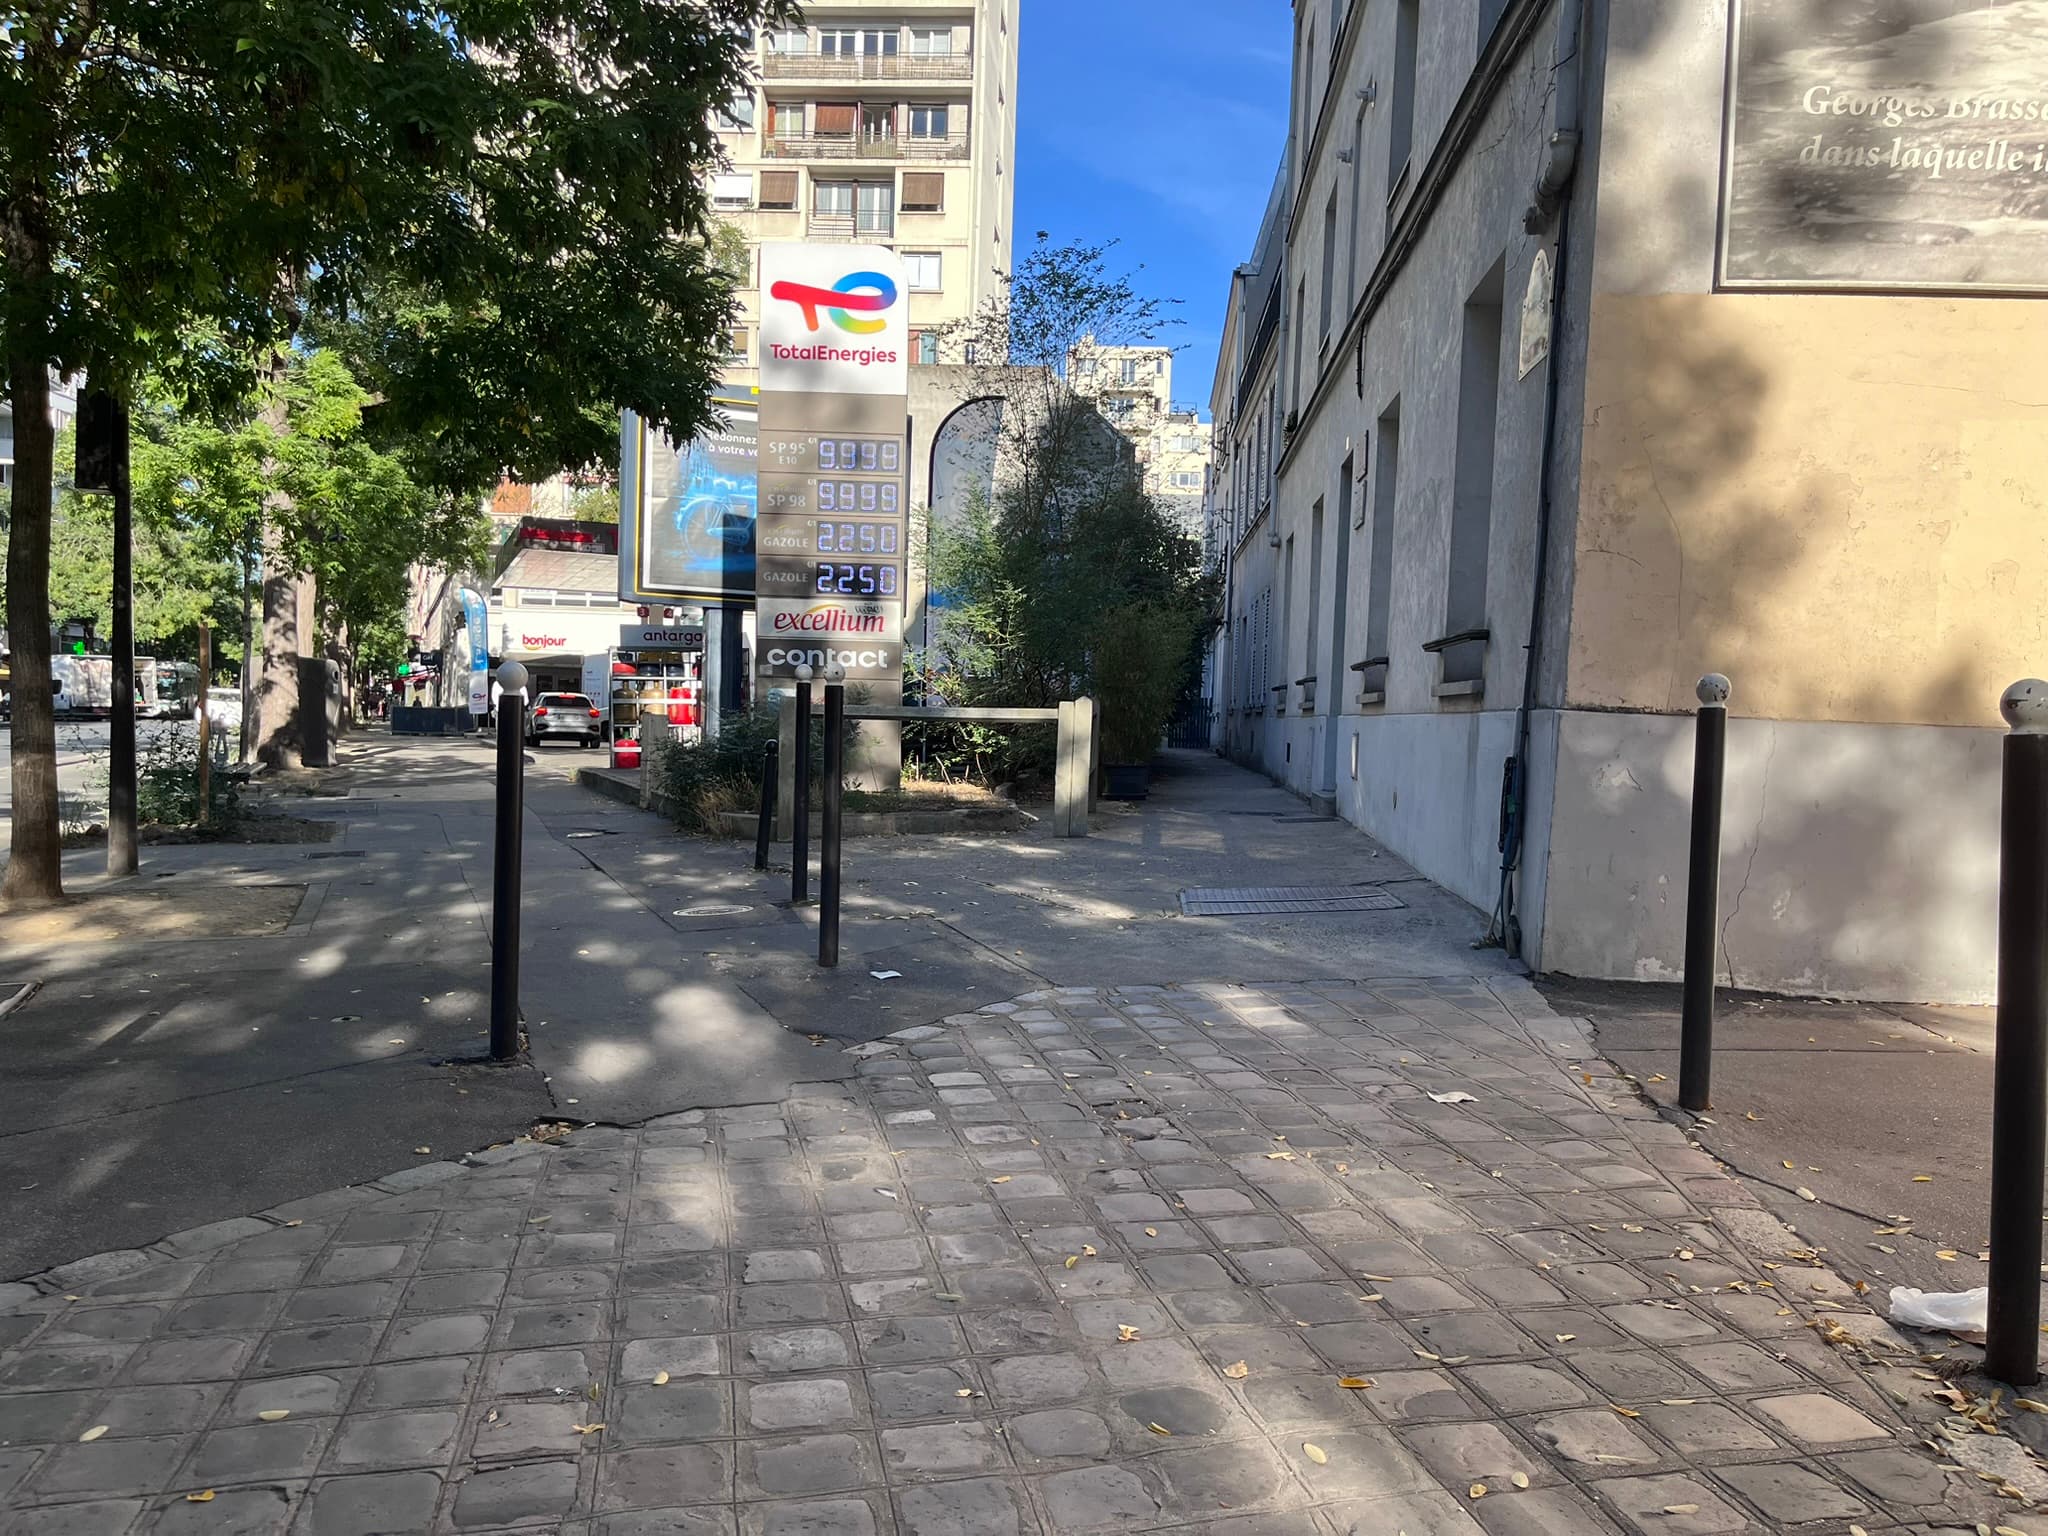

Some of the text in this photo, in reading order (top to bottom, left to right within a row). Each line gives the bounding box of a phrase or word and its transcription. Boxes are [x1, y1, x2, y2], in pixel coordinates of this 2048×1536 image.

[1803, 86, 1936, 126] Georges
[1800, 135, 2048, 179] dans laquelle i
[769, 343, 897, 366] TotalEnergies
[718, 446, 745, 456] votre
[769, 441, 806, 455] SP 95
[767, 494, 806, 507] SP 98
[763, 536, 809, 548] GAZOLE
[818, 523, 897, 552] 2.250
[763, 571, 809, 583] GAZOLE
[817, 564, 896, 594] 2.250
[774, 609, 886, 634] excellium
[522, 634, 567, 648] bonjour
[767, 648, 888, 669] contact
